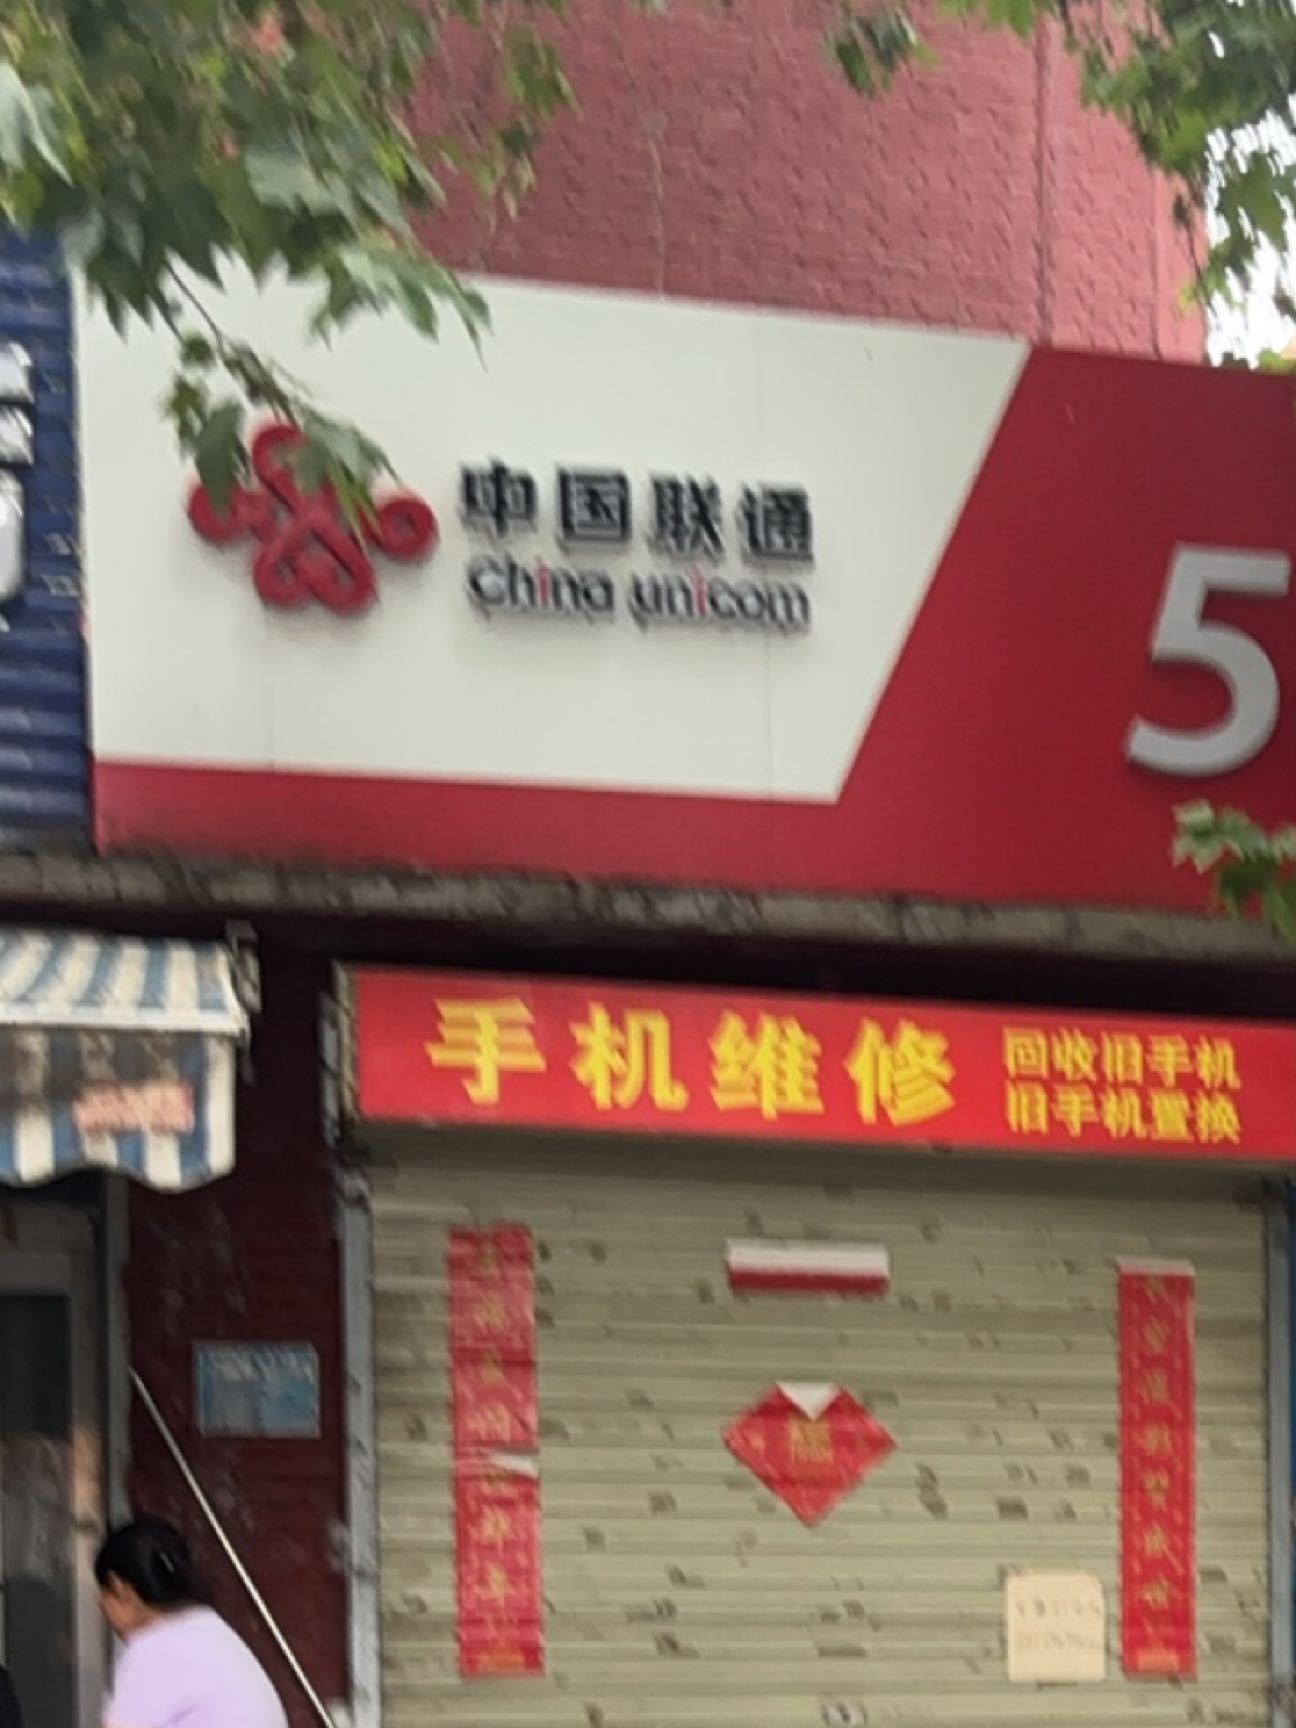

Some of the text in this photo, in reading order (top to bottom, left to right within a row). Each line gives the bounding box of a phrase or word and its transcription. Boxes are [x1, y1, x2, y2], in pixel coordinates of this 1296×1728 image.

[458, 456, 814, 568] 中国联通
[630, 566, 812, 626] unicom
[424, 996, 958, 1126] 手机维修
[1002, 1026, 1242, 1090] 回收旧手机
[1004, 1080, 1242, 1144] 旧手机置换
